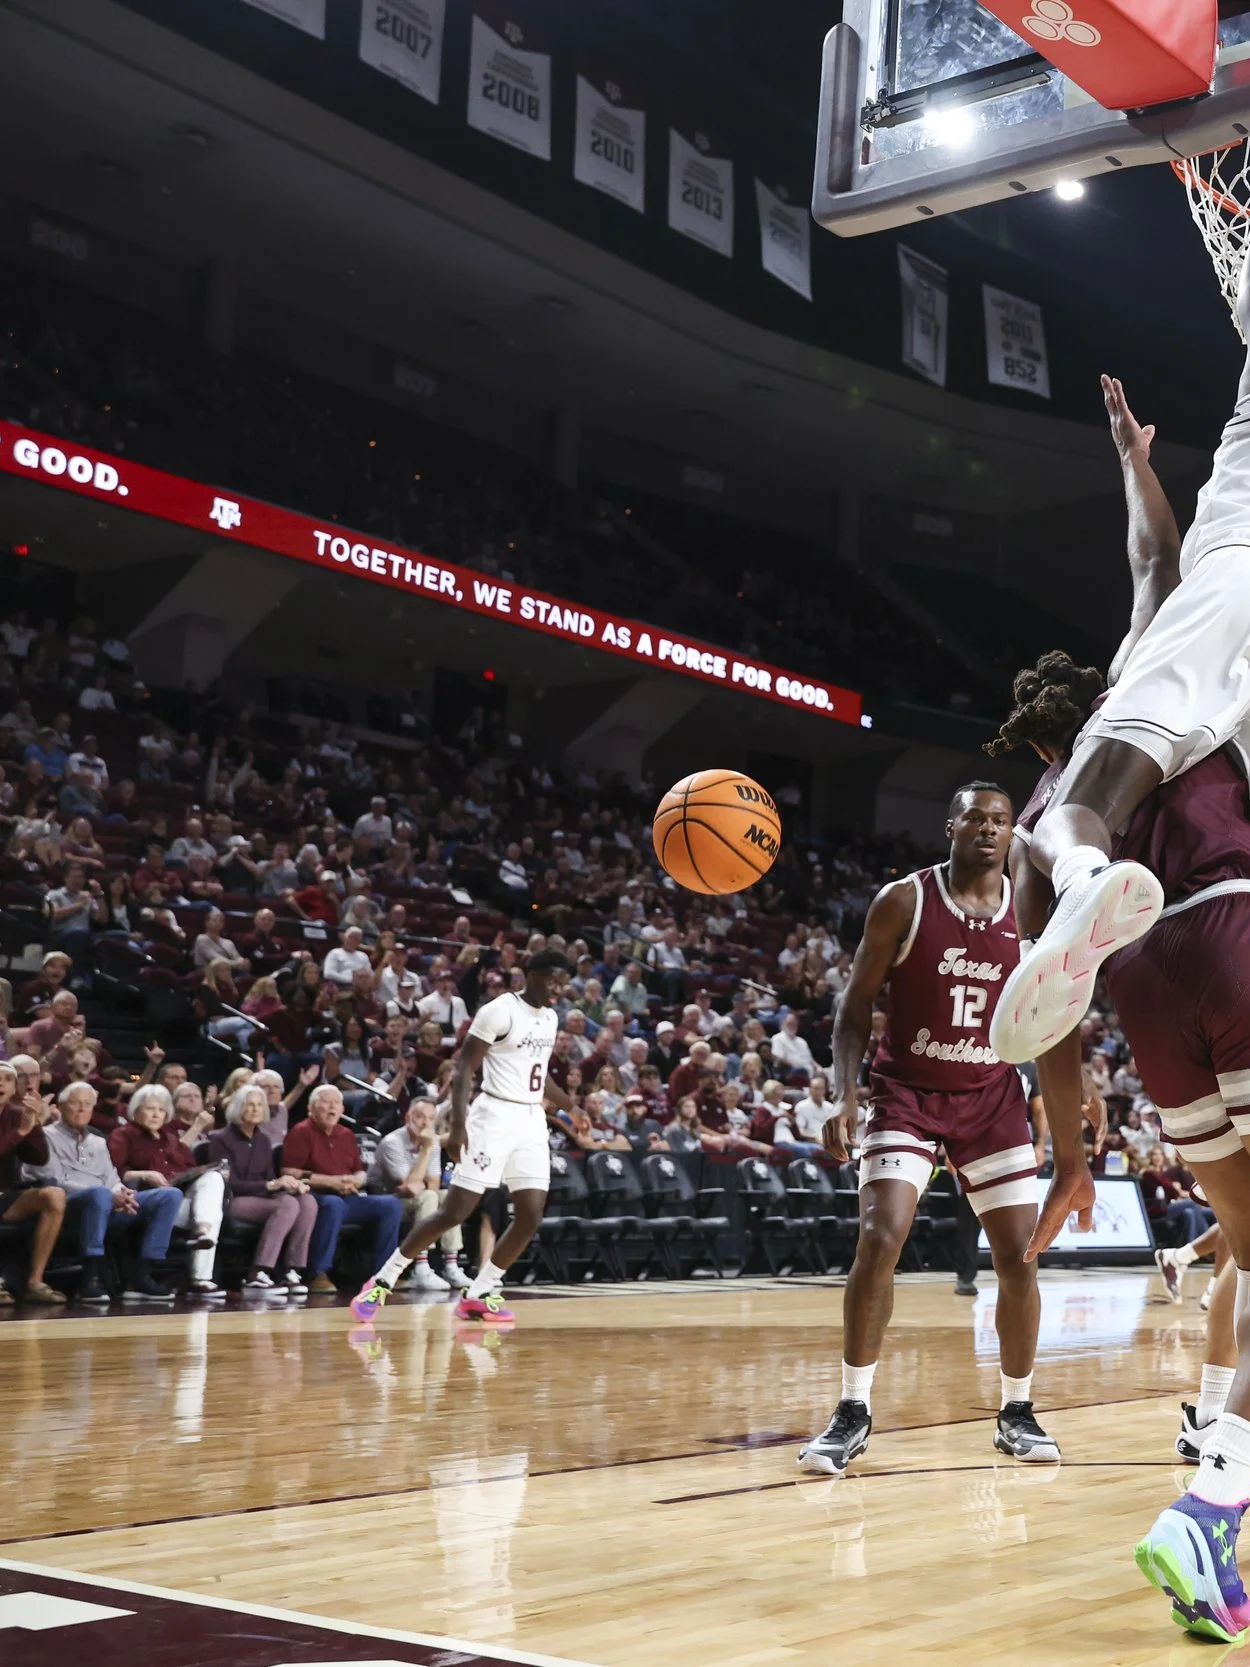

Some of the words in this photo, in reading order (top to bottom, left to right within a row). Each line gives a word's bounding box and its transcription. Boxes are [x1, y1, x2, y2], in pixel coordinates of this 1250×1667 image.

[375, 7, 432, 60] 2007
[590, 130, 634, 174] 2010
[682, 180, 723, 221] 2013
[13, 438, 129, 497] GOOD.
[313, 530, 463, 602] TOGETHER,
[473, 580, 512, 613] WE
[520, 596, 595, 637] STAND
[601, 622, 631, 649] AS
[636, 633, 653, 656] A
[658, 638, 727, 678] FORCE
[732, 661, 772, 692] FOR
[775, 676, 834, 711] GOOD.
[937, 947, 1002, 981] Texas
[949, 984, 988, 1028] 12
[529, 1063, 542, 1092] 6
